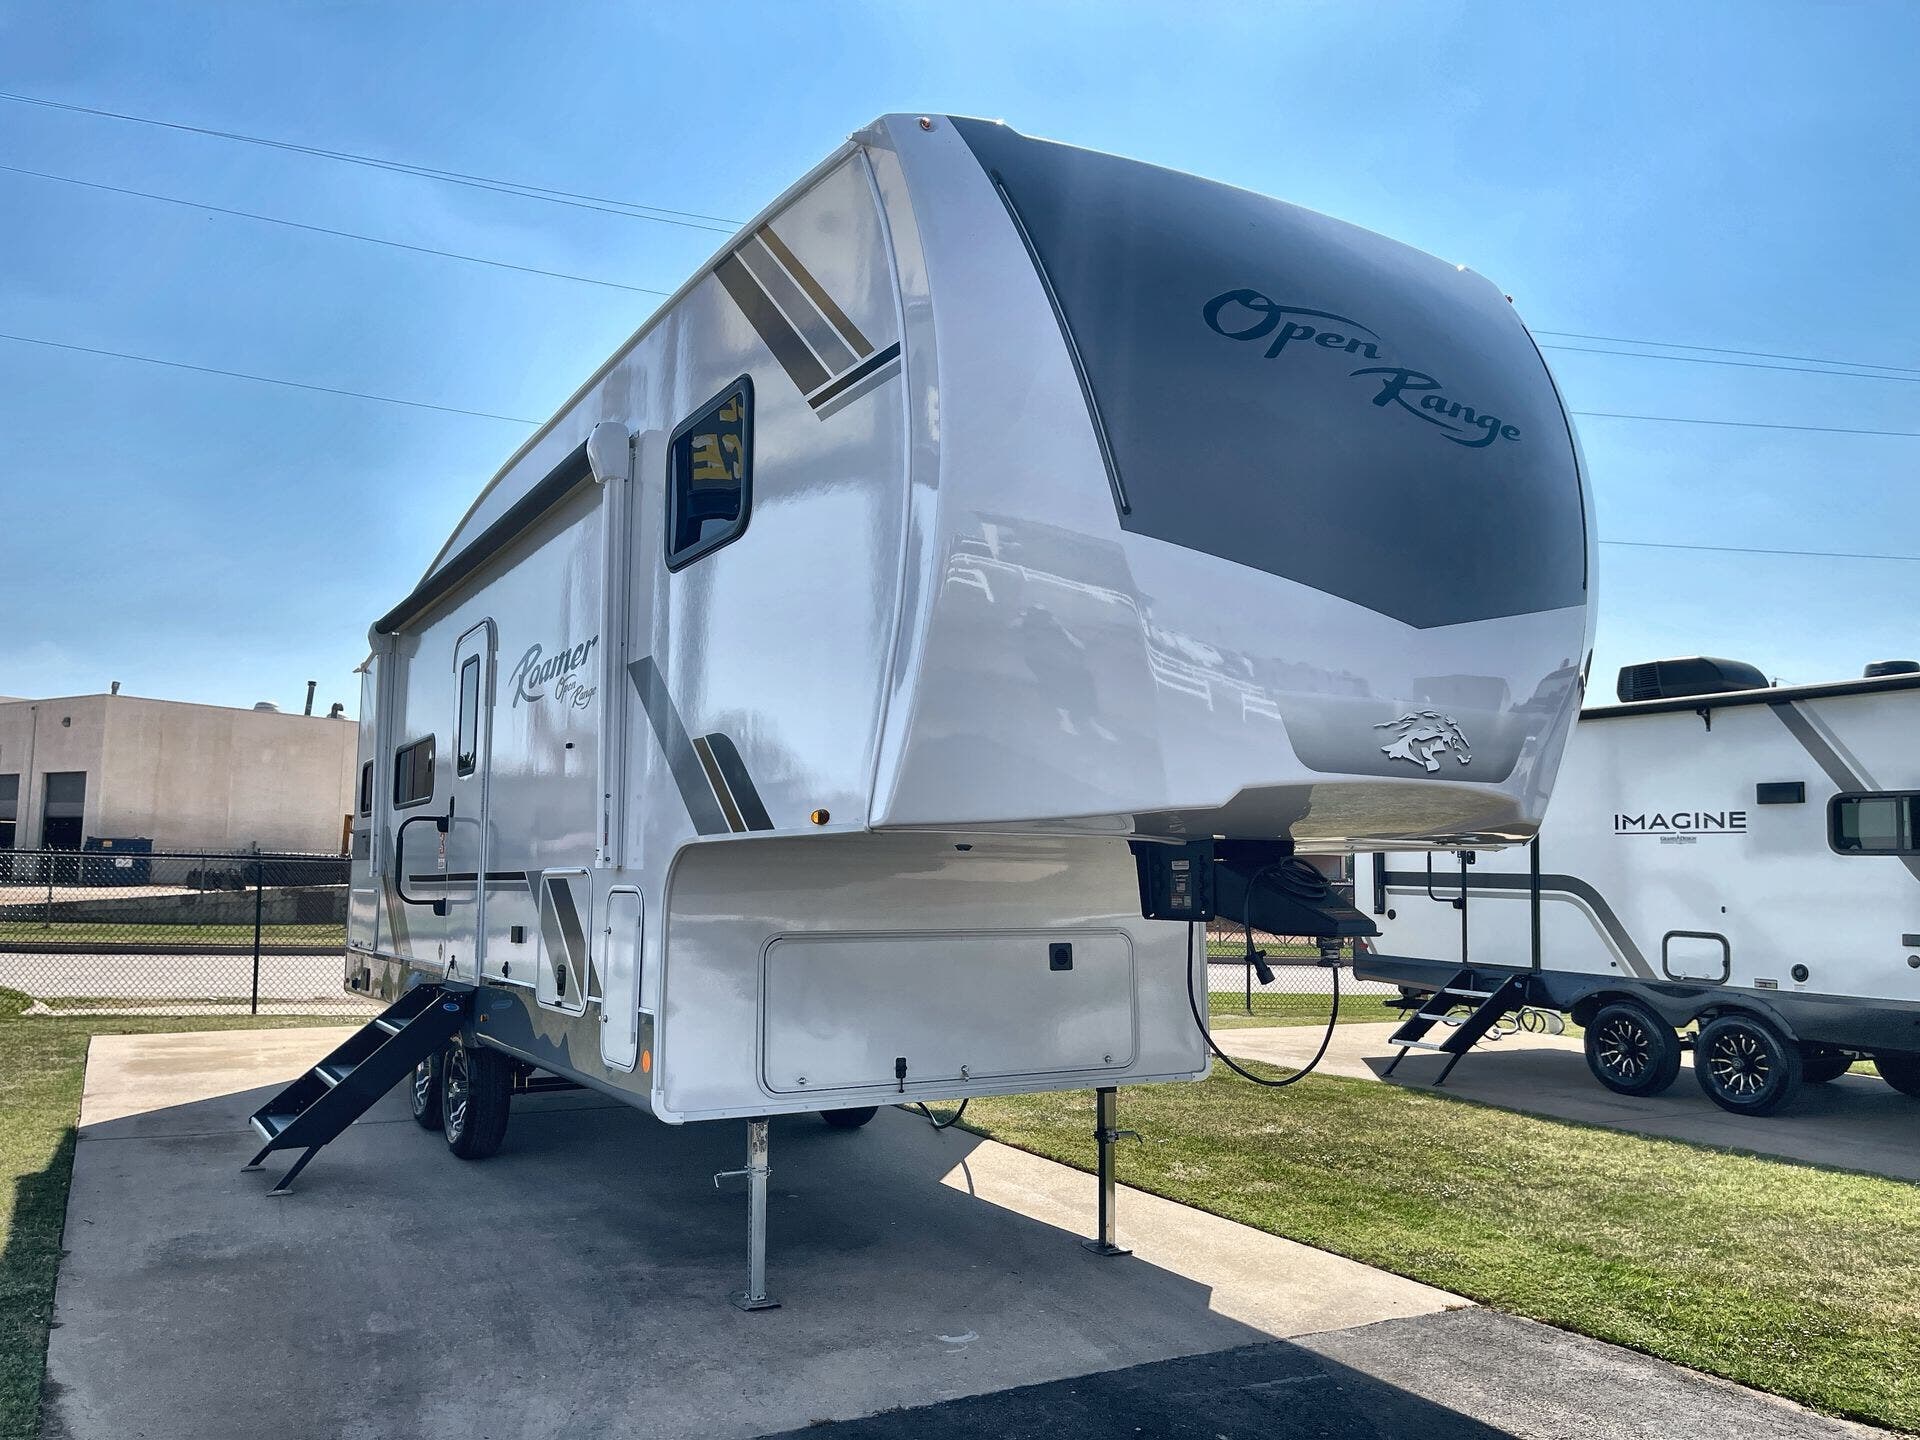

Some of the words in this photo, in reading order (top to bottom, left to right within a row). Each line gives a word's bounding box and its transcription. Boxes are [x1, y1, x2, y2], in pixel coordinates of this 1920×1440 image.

[1202, 288, 1382, 359] Open
[1349, 367, 1521, 448] Range
[508, 634, 599, 709] Roamer
[555, 673, 577, 704] Open
[571, 684, 597, 710] Range
[1614, 811, 1747, 830] IMAGINE
